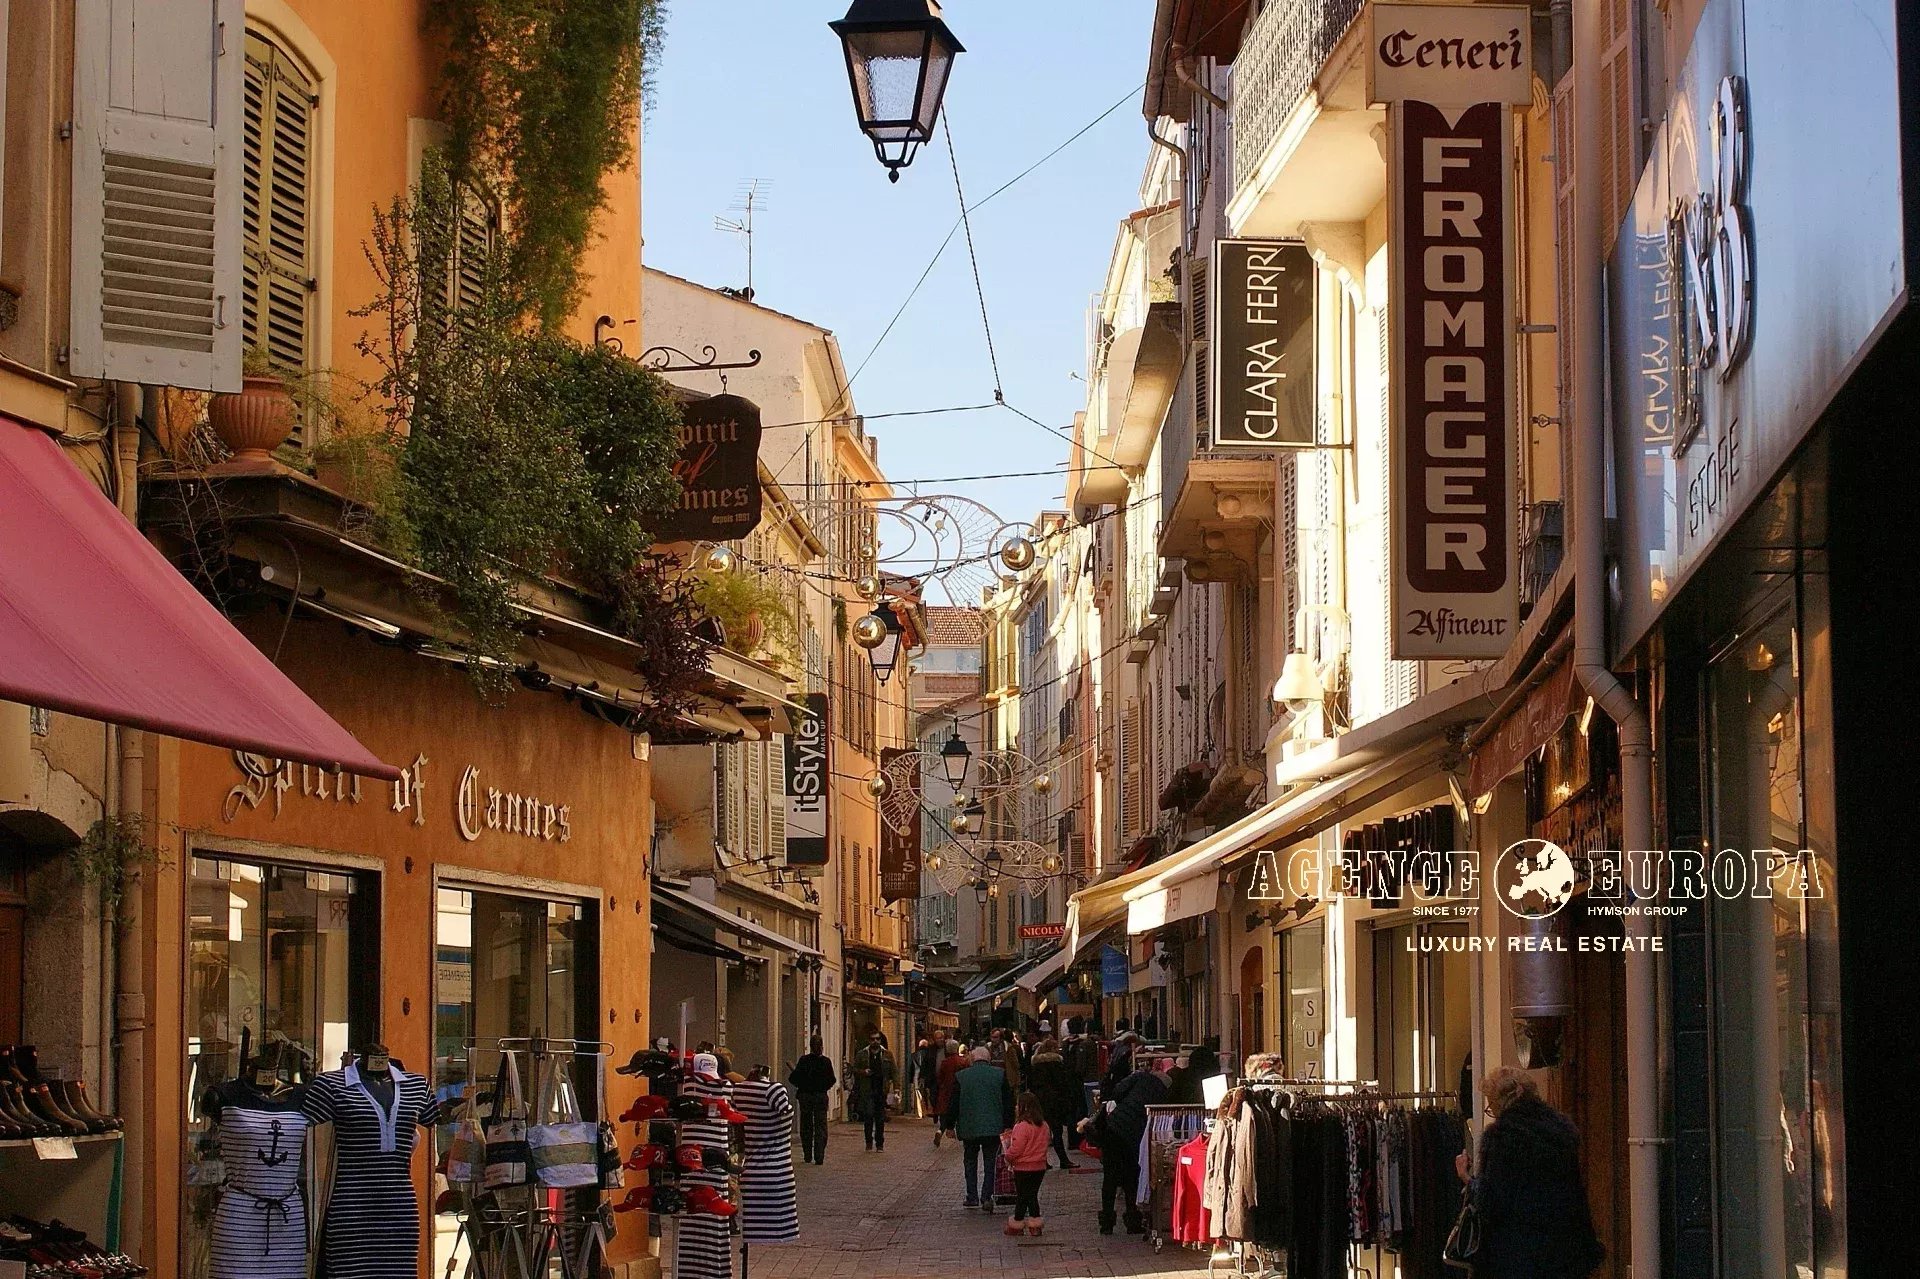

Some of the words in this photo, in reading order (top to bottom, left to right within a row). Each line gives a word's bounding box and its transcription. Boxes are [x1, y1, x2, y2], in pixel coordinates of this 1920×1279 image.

[1379, 28, 1522, 70] Ceneri
[1246, 247, 1286, 325] FERRI
[1243, 338, 1287, 440] CLARA
[1422, 137, 1487, 571] FROMAGER
[678, 418, 739, 445] pirit
[1688, 417, 1740, 538] STORE
[1406, 607, 1508, 644] Affineur
[393, 751, 428, 827] of
[457, 764, 571, 843] Cannes
[793, 718, 825, 813] itStyle
[1023, 926, 1065, 936] NICOLAS
